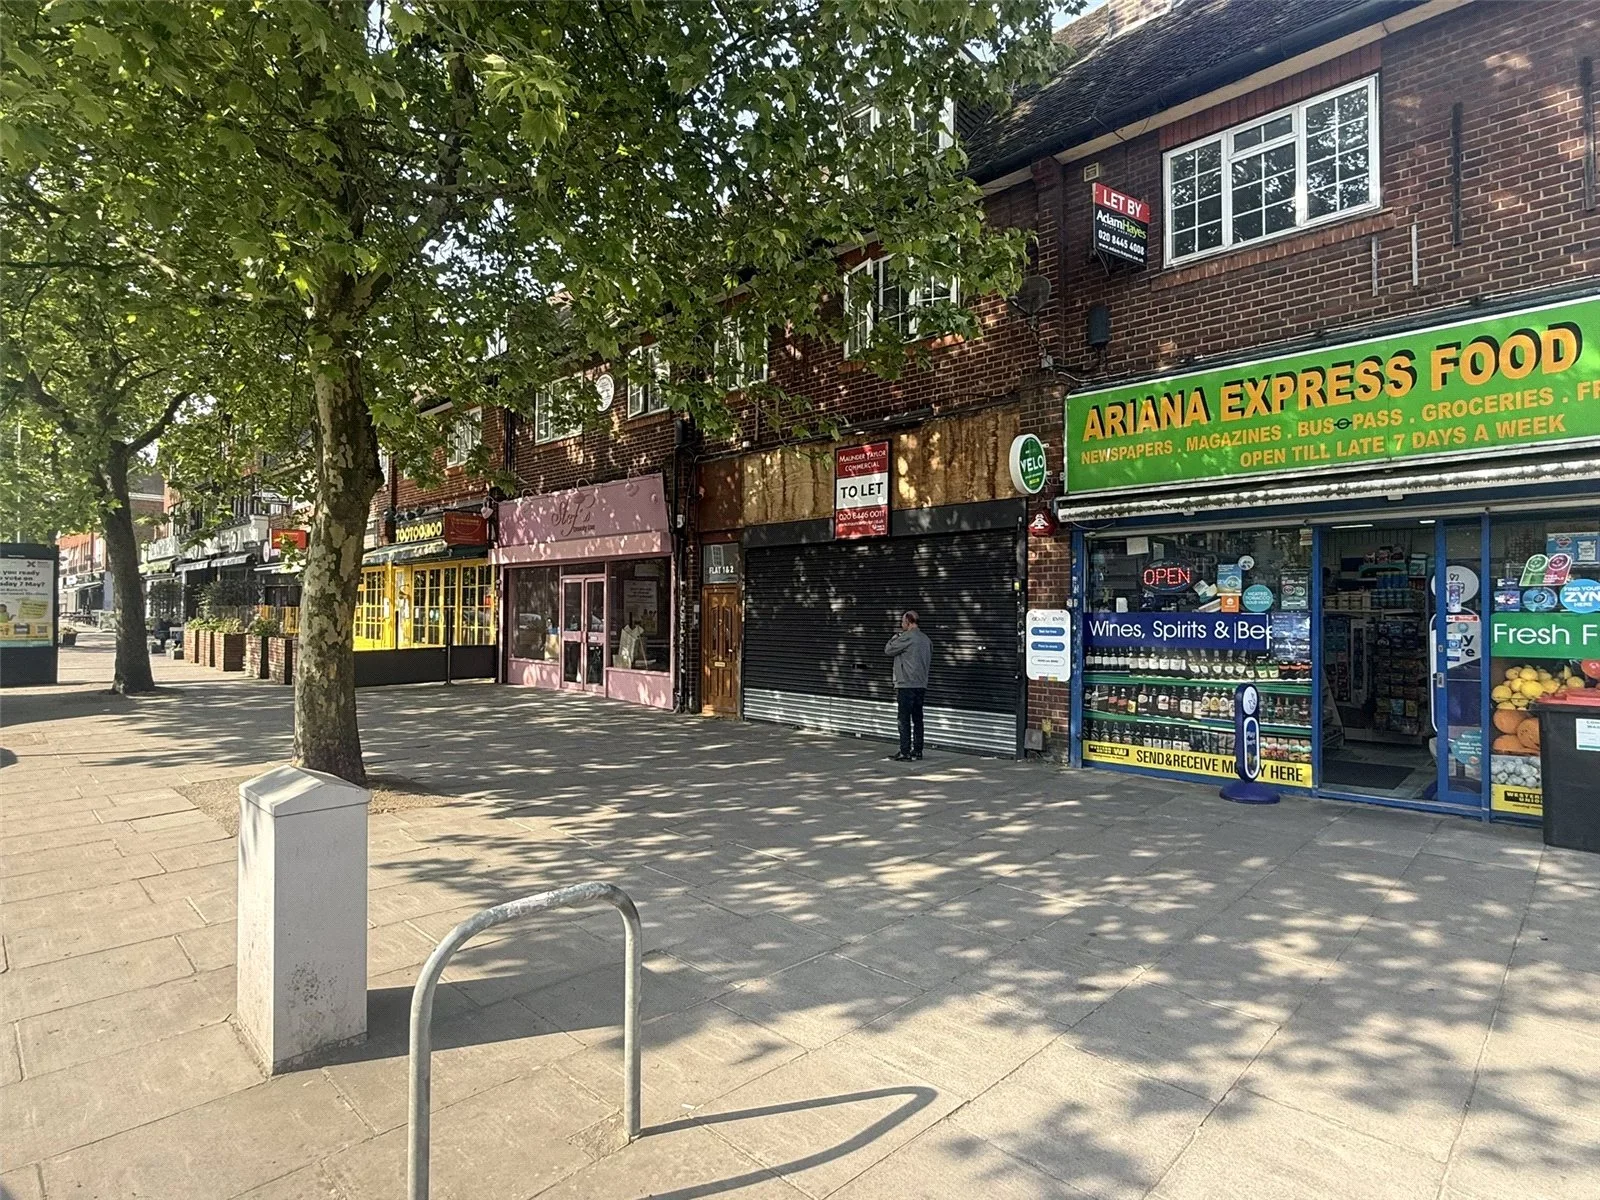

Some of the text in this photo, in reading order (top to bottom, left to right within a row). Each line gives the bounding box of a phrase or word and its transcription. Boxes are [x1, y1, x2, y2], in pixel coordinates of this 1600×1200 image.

[1104, 190, 1142, 217] LET BY
[1098, 229, 1111, 242] 020
[1111, 235, 1128, 249] 8445
[1082, 322, 1582, 442] ARIANA EXPRESS FOOD
[1081, 439, 1173, 464] NEWSPAPERS
[1186, 425, 1282, 452] MAGAZINES
[1297, 418, 1335, 437] BUS
[1352, 408, 1403, 430] PASS
[1421, 386, 1554, 422] GROCERIES
[1239, 413, 1566, 468] OPEN TILL LATE 7 DAYS A WEEK
[1020, 454, 1044, 473] VELO
[841, 482, 883, 499] TO LET
[708, 566, 721, 574] FLAT
[1143, 567, 1191, 585] OPEN
[1564, 592, 1600, 603] ZYN
[1088, 620, 1145, 639] Wines,
[1153, 620, 1207, 641] Spirits
[1213, 620, 1230, 639] &
[1493, 623, 1570, 645] Fresh
[1270, 765, 1304, 782] HERE
[1506, 791, 1543, 799] WESTER
